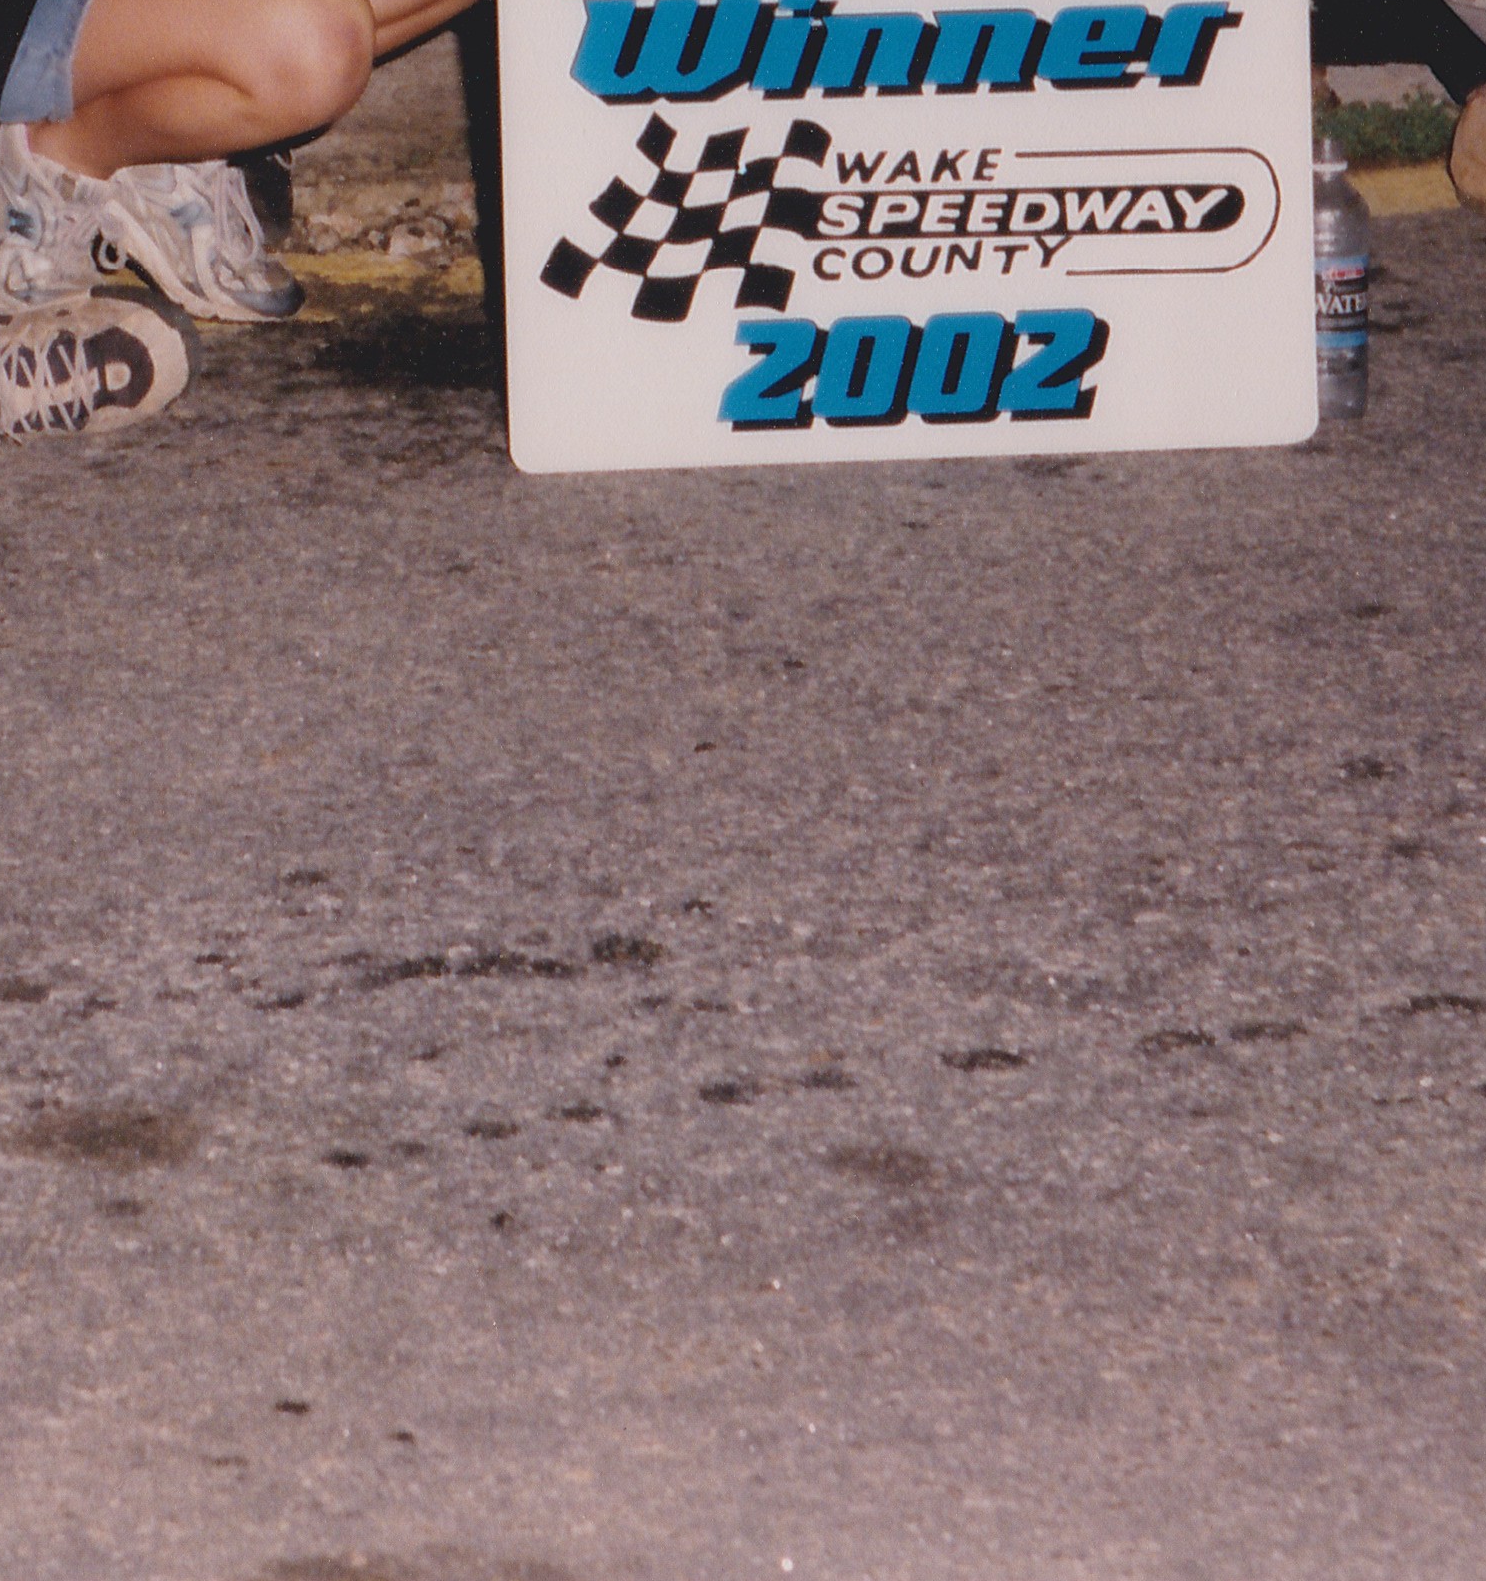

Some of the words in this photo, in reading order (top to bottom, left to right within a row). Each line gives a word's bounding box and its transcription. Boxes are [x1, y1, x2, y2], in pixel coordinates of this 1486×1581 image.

[834, 147, 1003, 184] WAKE
[816, 187, 1228, 236] SPEEDWAY
[811, 234, 1074, 280] COUNTY
[1315, 292, 1368, 316] WATE
[716, 307, 1111, 433] 2002
